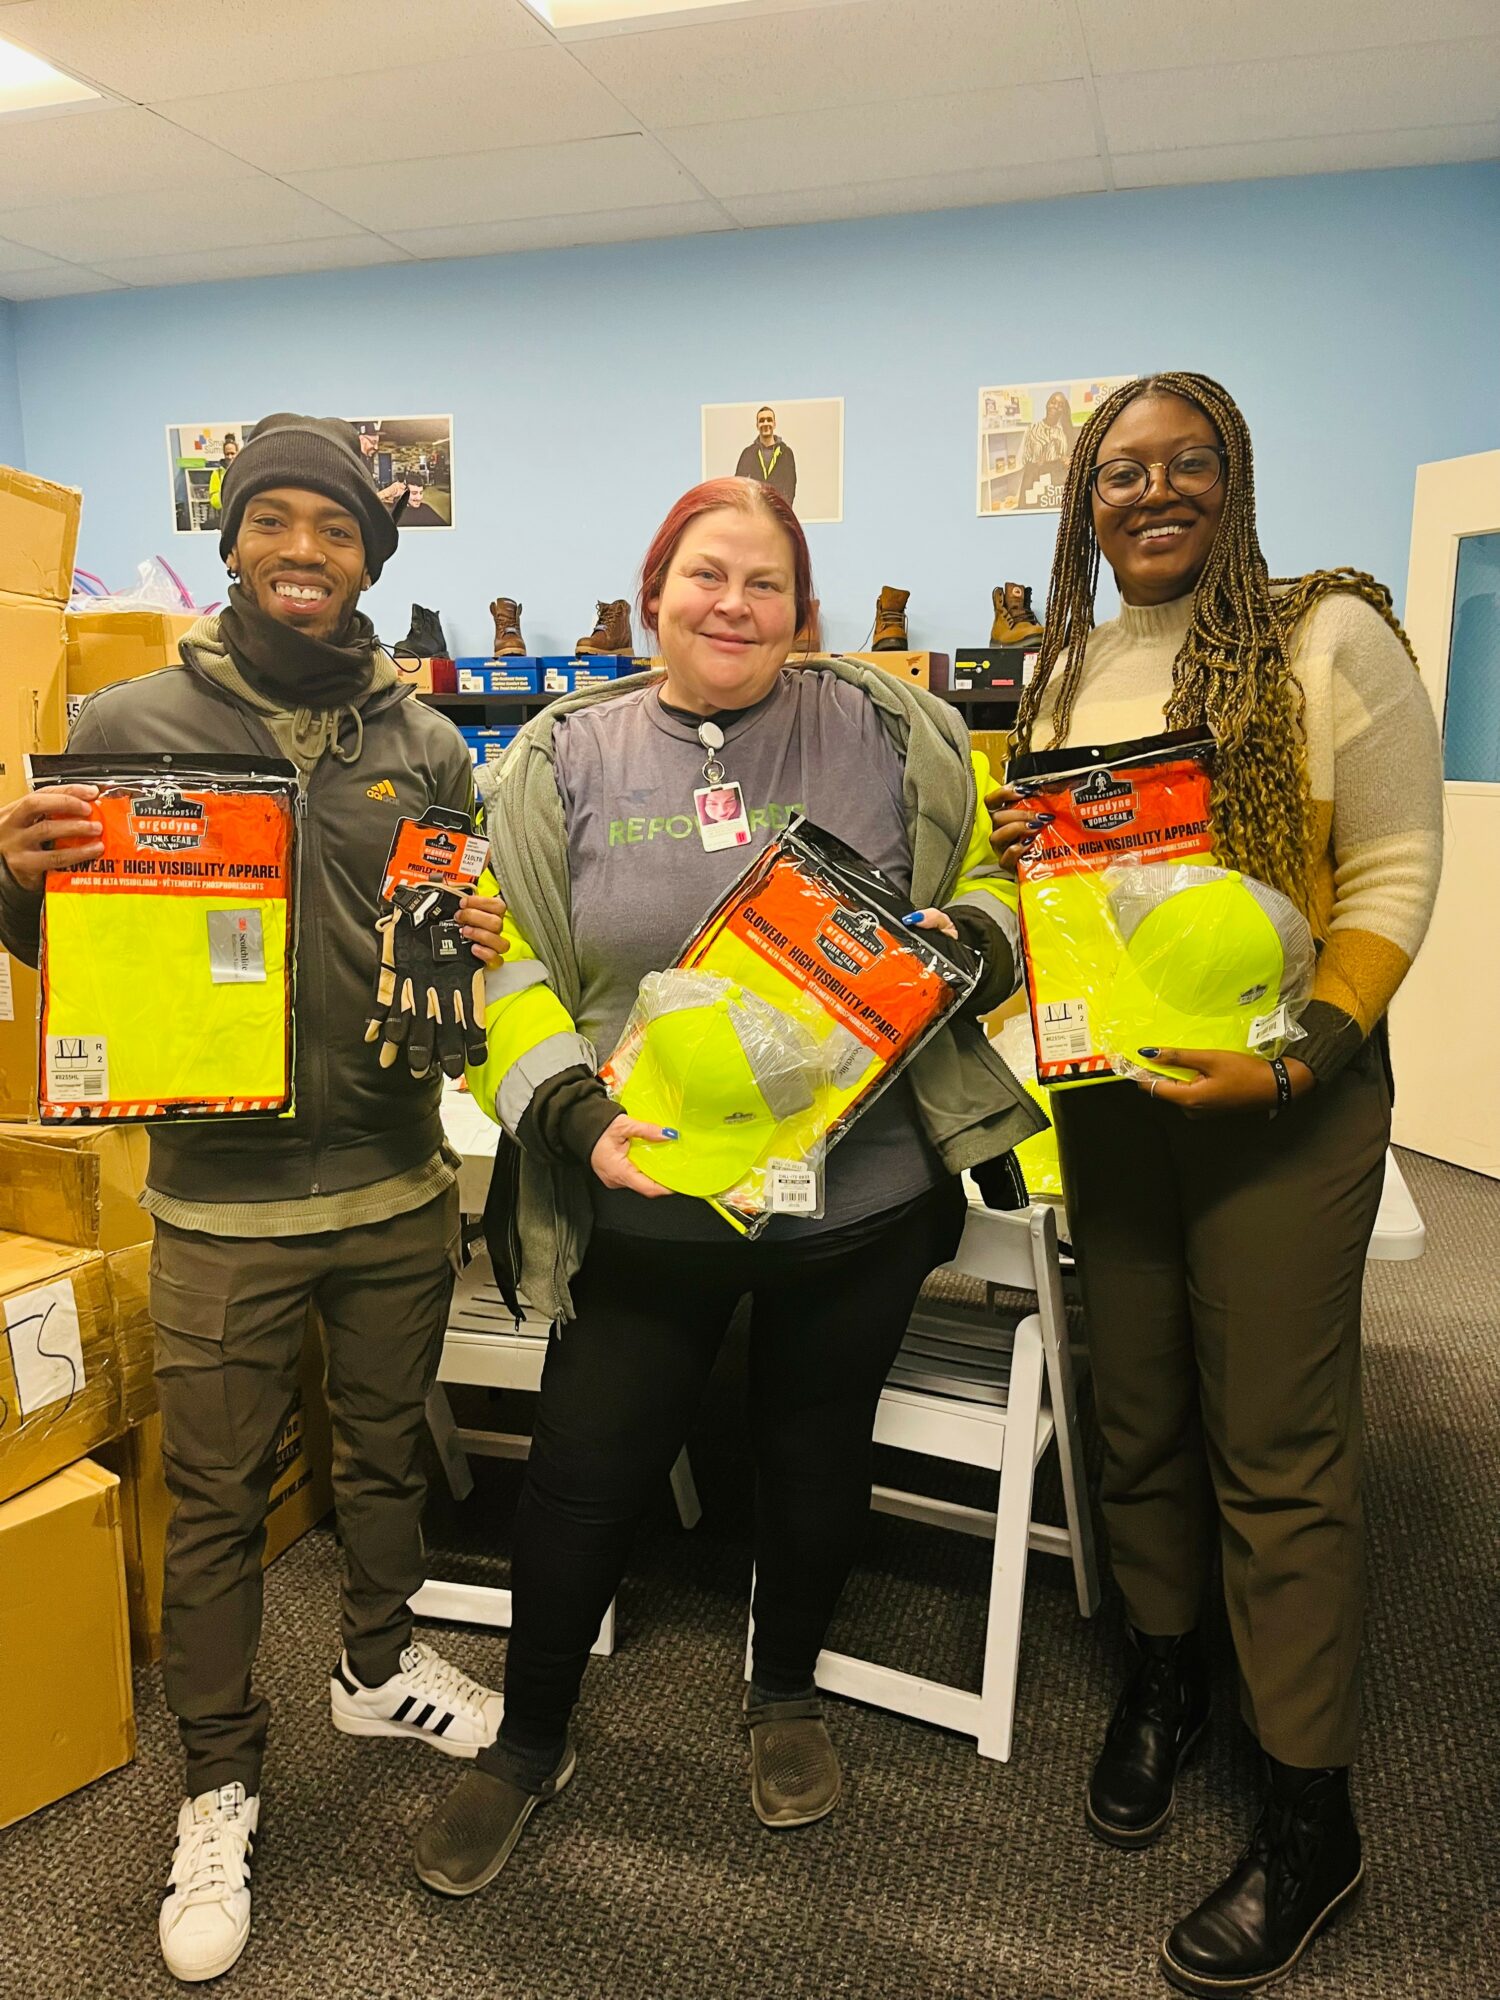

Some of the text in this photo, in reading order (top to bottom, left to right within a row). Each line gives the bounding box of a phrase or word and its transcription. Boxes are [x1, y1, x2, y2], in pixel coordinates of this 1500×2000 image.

[1040, 495, 1063, 507] Sum
[1080, 799, 1131, 816] ergodyne
[138, 820, 198, 832] ergodyne
[1078, 840, 1104, 855] HIGH
[1104, 829, 1161, 851] VISIBILITY
[123, 859, 156, 874] HIGH
[158, 861, 225, 876] VISIBILITY
[228, 863, 281, 879] APPAREL
[826, 925, 869, 963] ergodyne
[743, 907, 902, 1045] GLOWEAR HIGH VISIBILITY APPAREL
